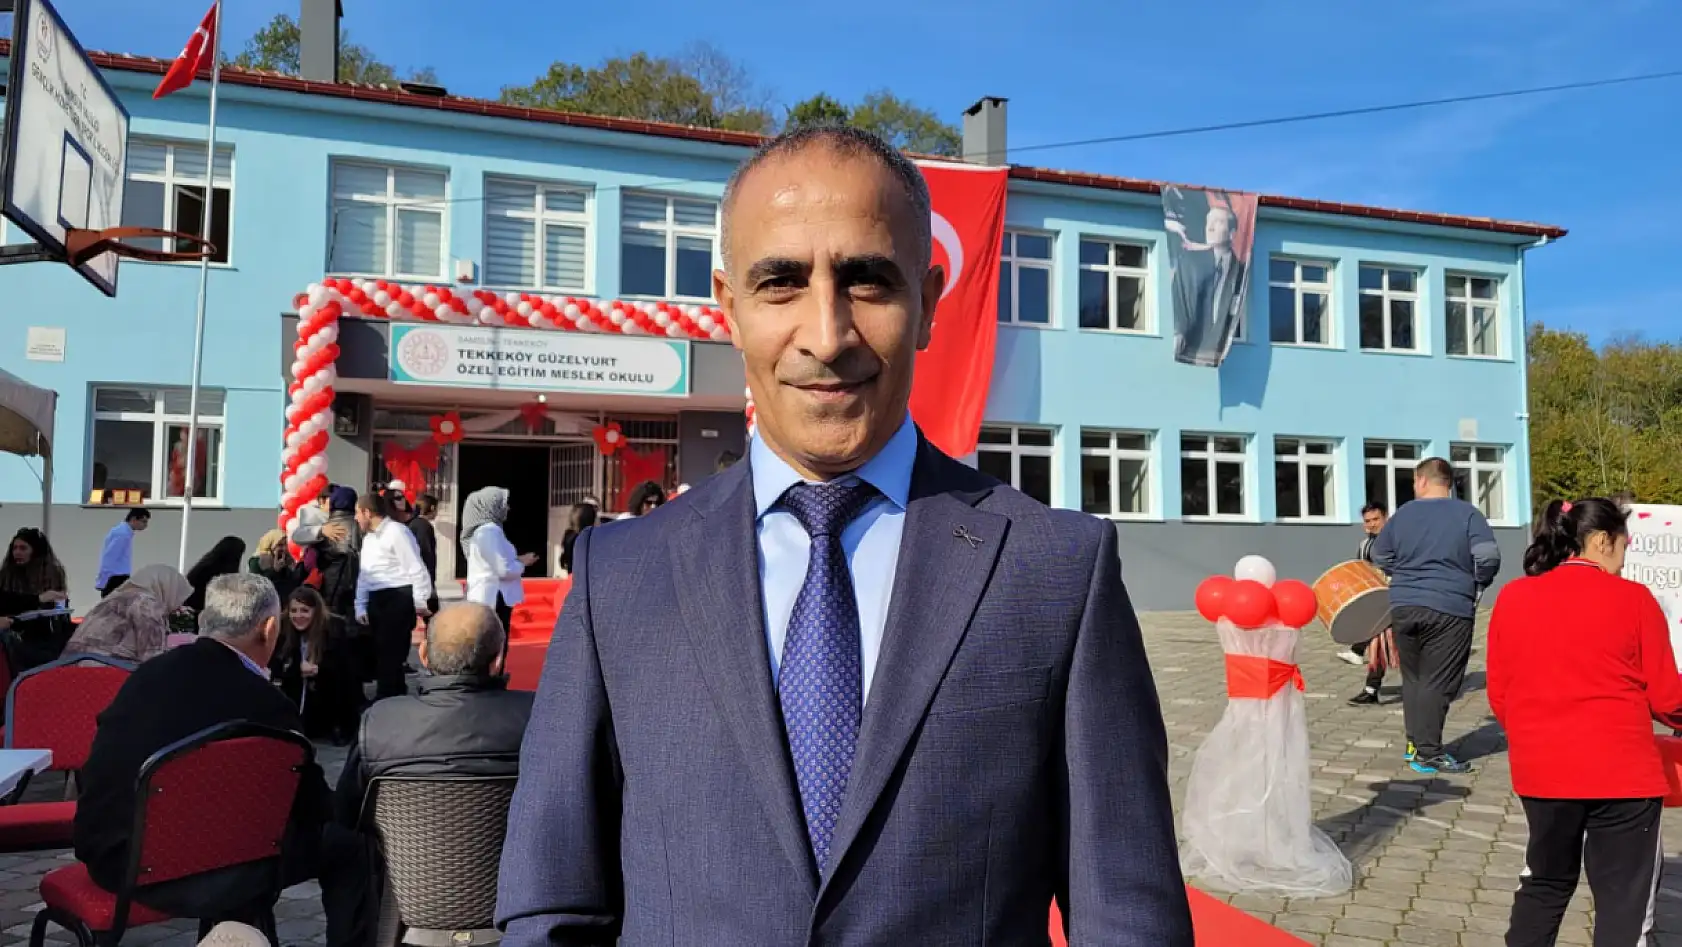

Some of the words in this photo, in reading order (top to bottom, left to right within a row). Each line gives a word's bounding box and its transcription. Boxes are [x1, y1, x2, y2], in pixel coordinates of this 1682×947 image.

[457, 348, 533, 362] TEKKEKÖY
[538, 351, 617, 367] GÜZELYURT
[457, 362, 493, 375] ÖZEL
[498, 365, 547, 378] EĞİTİM
[551, 368, 605, 382] MESLEK
[609, 372, 654, 384] OKULU
[1627, 563, 1682, 590] Hoşg
